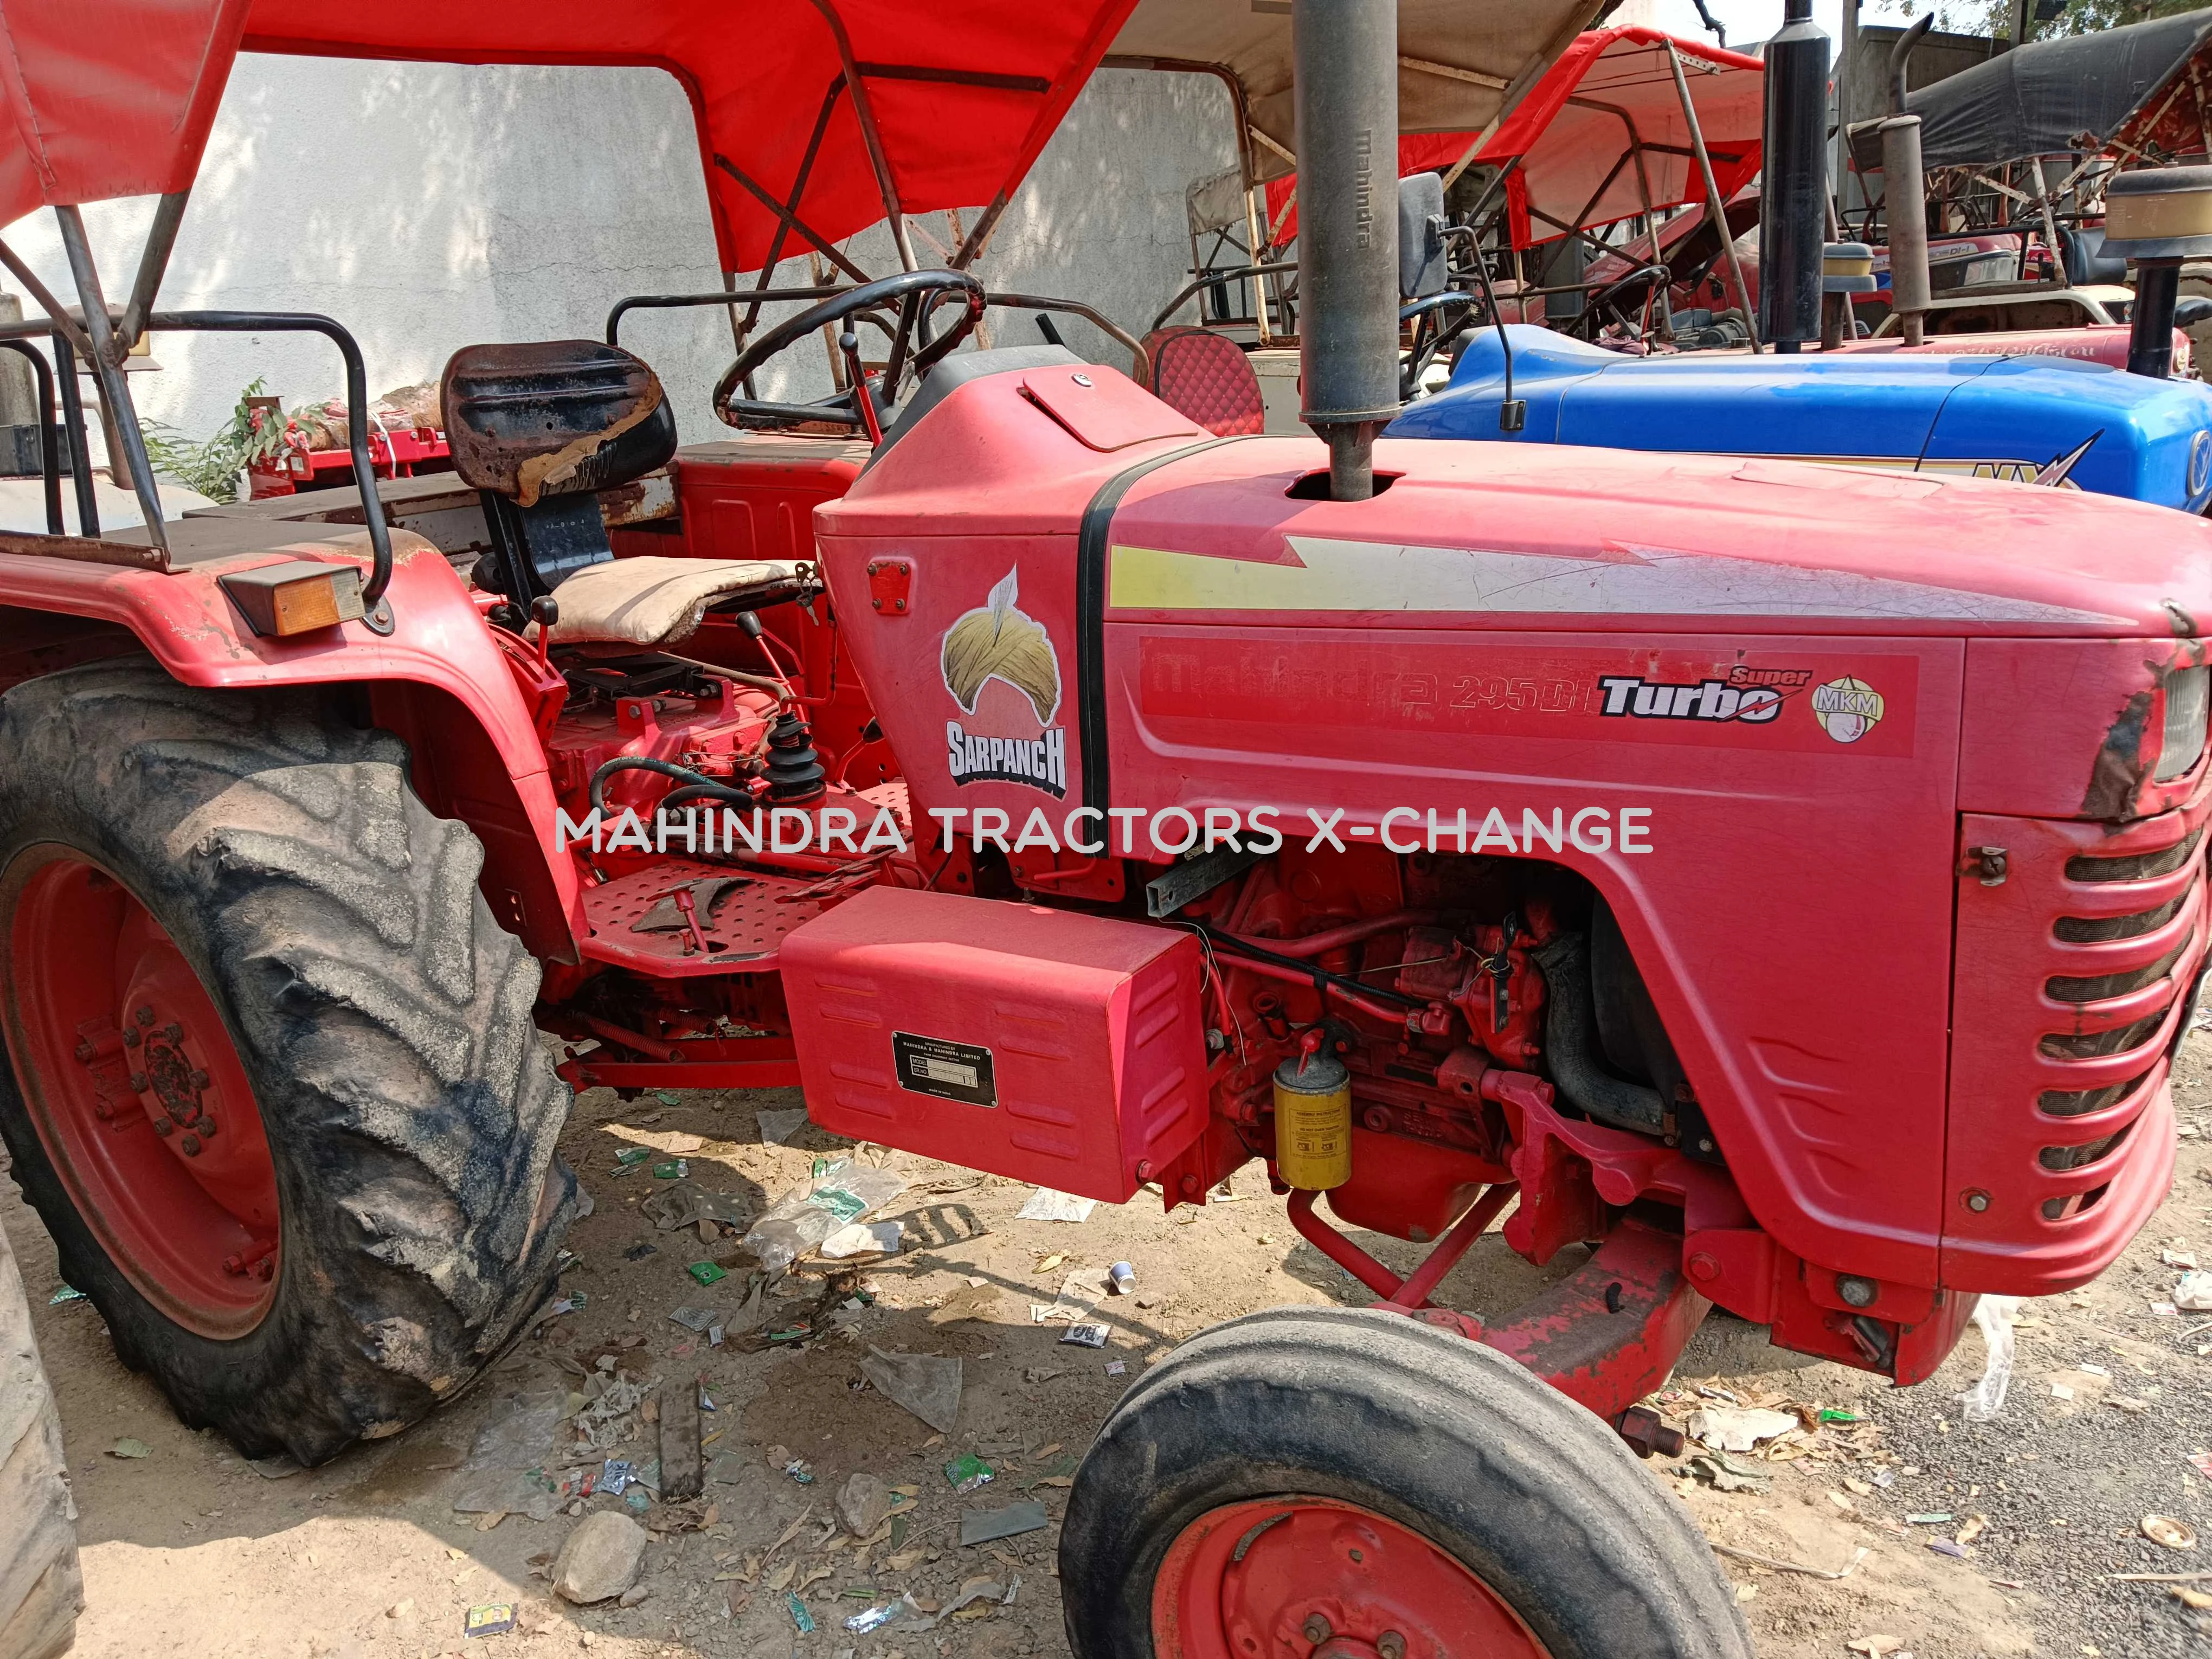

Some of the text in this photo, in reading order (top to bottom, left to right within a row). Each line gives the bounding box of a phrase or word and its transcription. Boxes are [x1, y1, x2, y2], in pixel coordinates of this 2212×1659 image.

[1356, 128, 1374, 250] mahindra
[1729, 666, 1812, 686] Super
[1600, 677, 1782, 723] Turbo
[1817, 686, 1877, 716] MKM
[946, 721, 1066, 797] SARPANCH
[903, 1041, 927, 1051] MAHINDRA
[934, 1048, 959, 1057] MAHINDRA
[912, 1058, 927, 1066] MODEL
